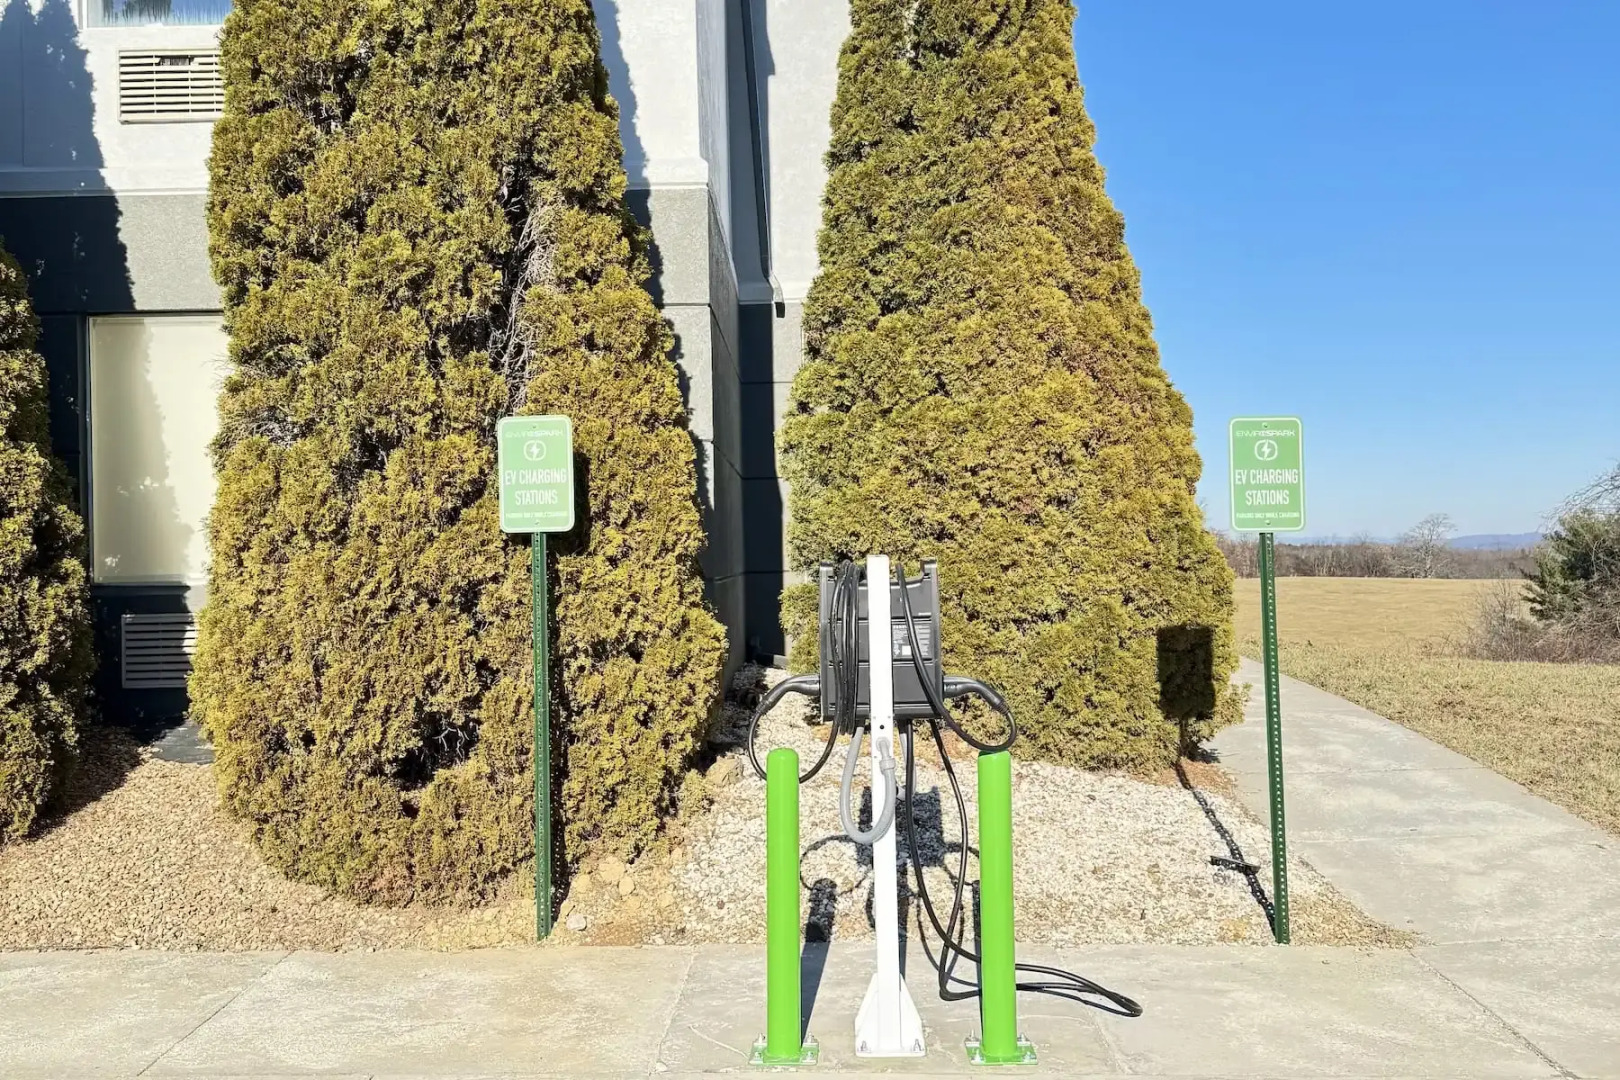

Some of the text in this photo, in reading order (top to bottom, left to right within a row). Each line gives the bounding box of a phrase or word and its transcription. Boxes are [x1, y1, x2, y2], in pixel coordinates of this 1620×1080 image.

[505, 468, 567, 485] EV CHARGING
[1235, 469, 1298, 484] EV CHARGING
[515, 490, 558, 505] STATIONS
[1245, 490, 1289, 505] STATIONS
